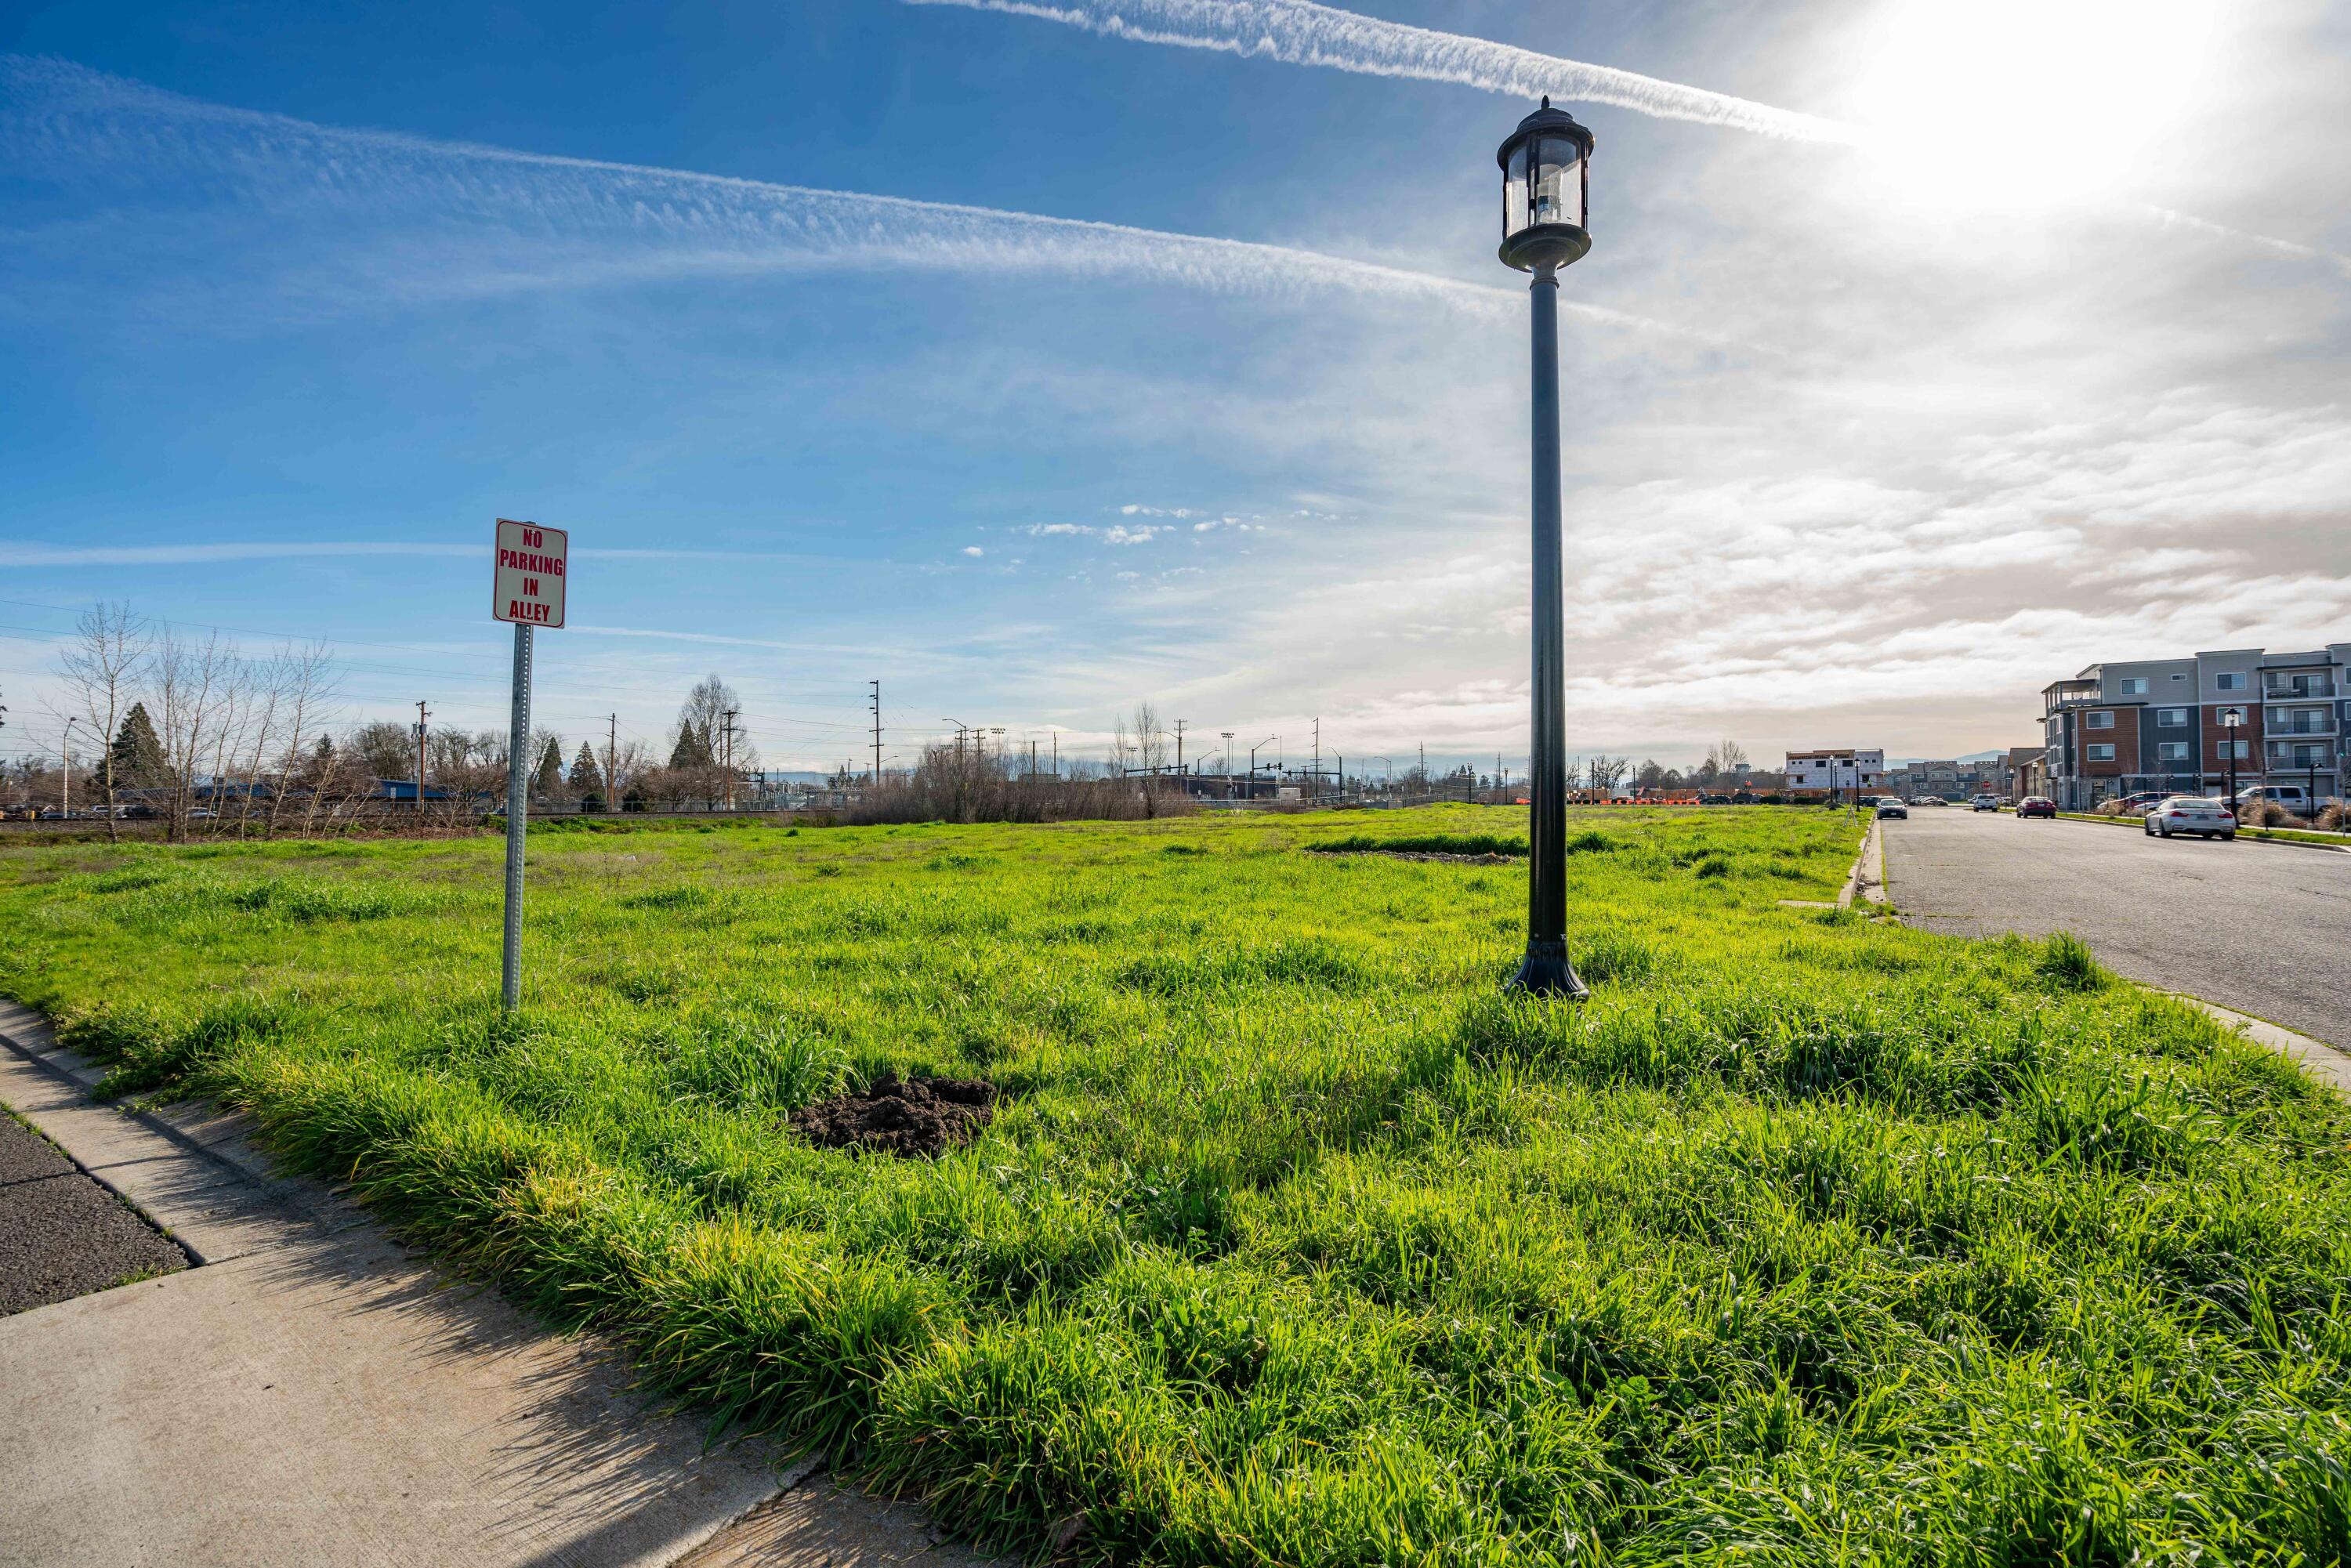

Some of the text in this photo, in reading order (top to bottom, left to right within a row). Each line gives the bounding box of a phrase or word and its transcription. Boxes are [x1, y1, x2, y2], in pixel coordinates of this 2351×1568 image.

[523, 529, 542, 548] NO
[500, 549, 563, 577] PARKING
[523, 578, 538, 596] IN
[509, 600, 550, 622] ALLEY
